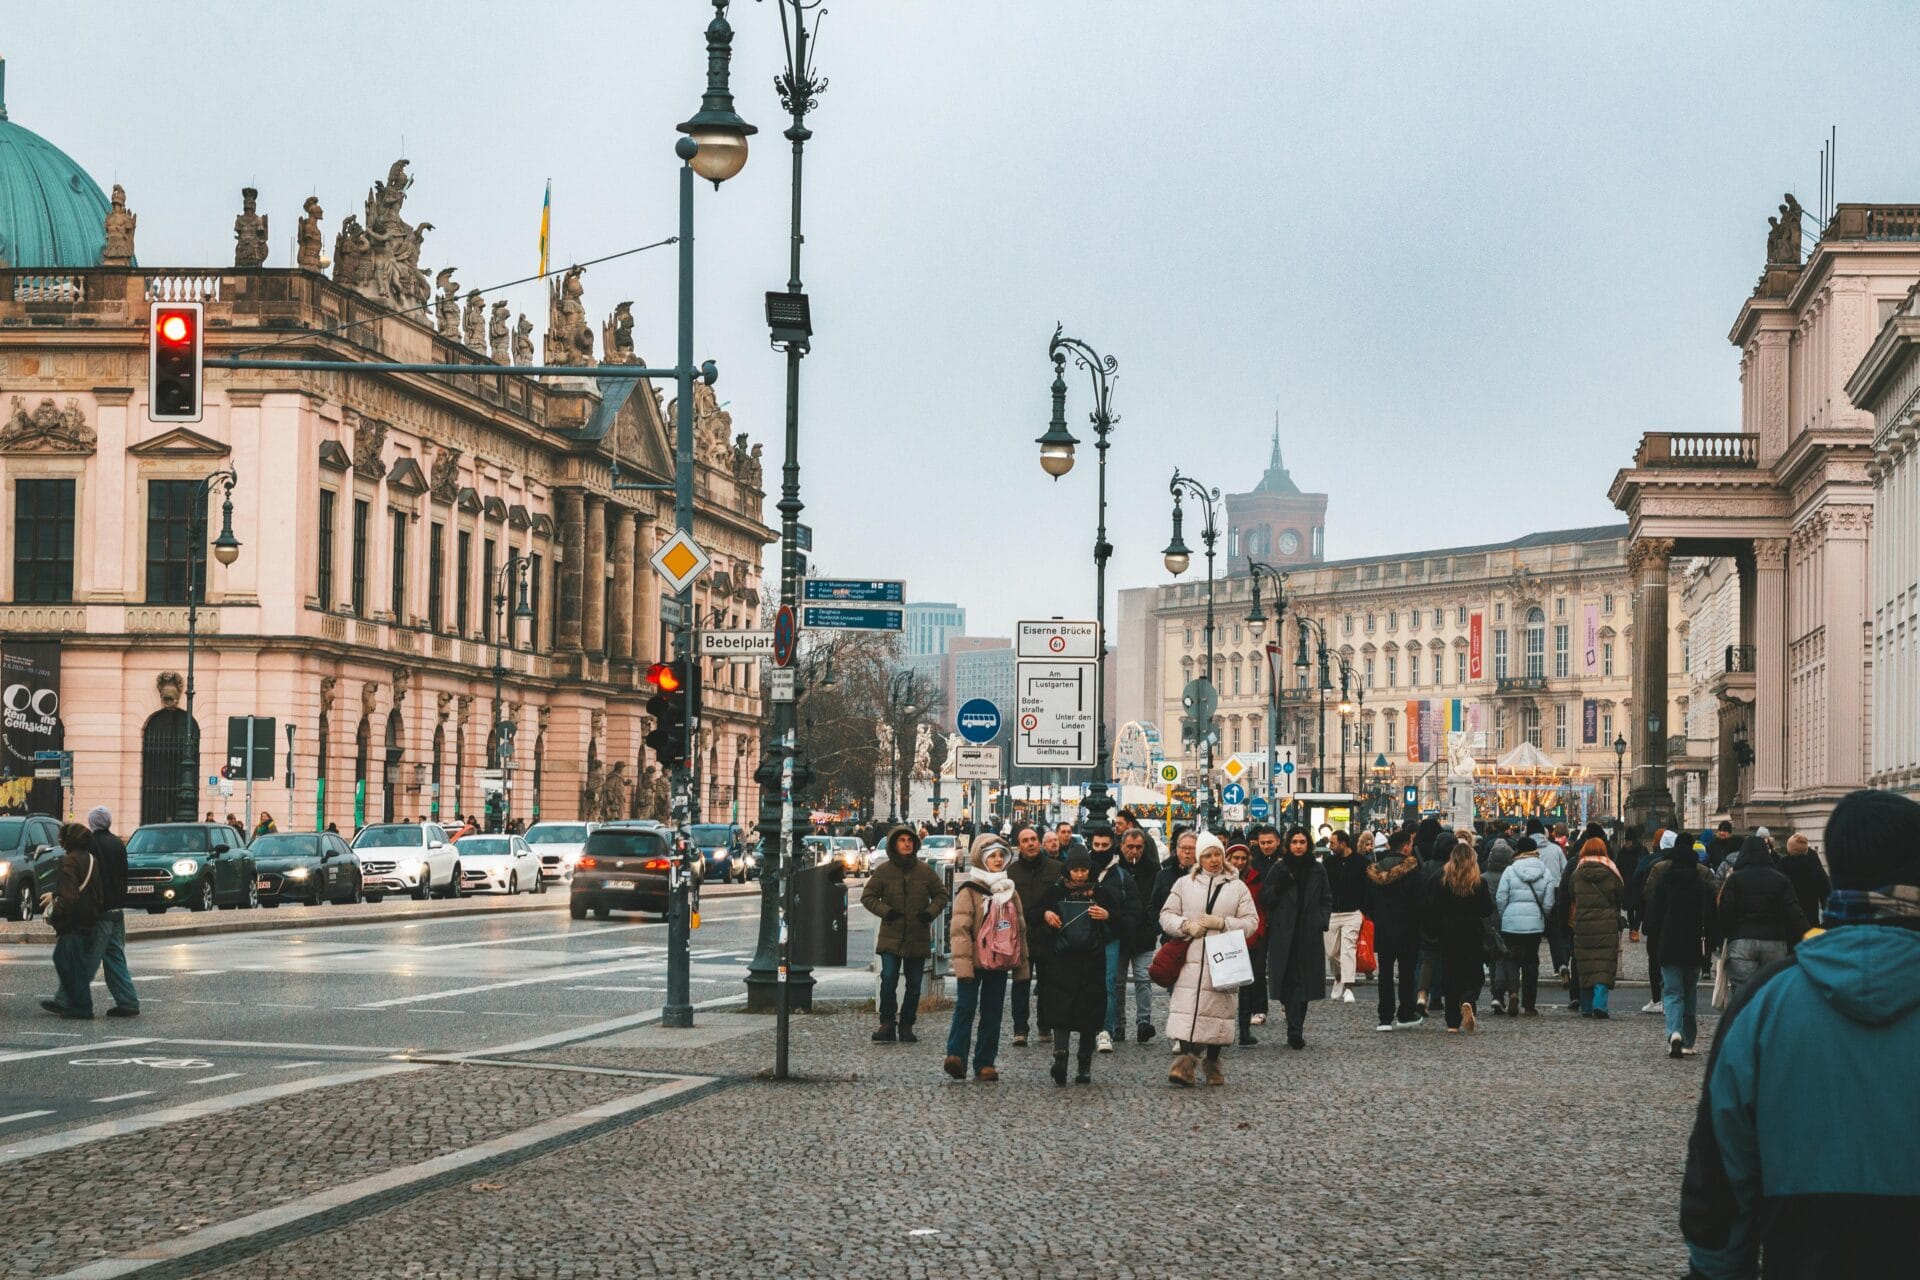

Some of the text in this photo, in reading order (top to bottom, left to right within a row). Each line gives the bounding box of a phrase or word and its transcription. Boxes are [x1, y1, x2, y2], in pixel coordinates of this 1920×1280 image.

[1023, 626, 1092, 635] Eiserne Brücke
[1035, 681, 1074, 689] Lustgarten
[1021, 697, 1044, 705] Bode-
[3, 708, 57, 726] Rein ins
[1055, 713, 1075, 721] Unter
[4, 718, 53, 736] Gemälde!
[1036, 748, 1070, 756] Gießhaus
[1166, 768, 1174, 778] H
[1406, 791, 1416, 801] U
